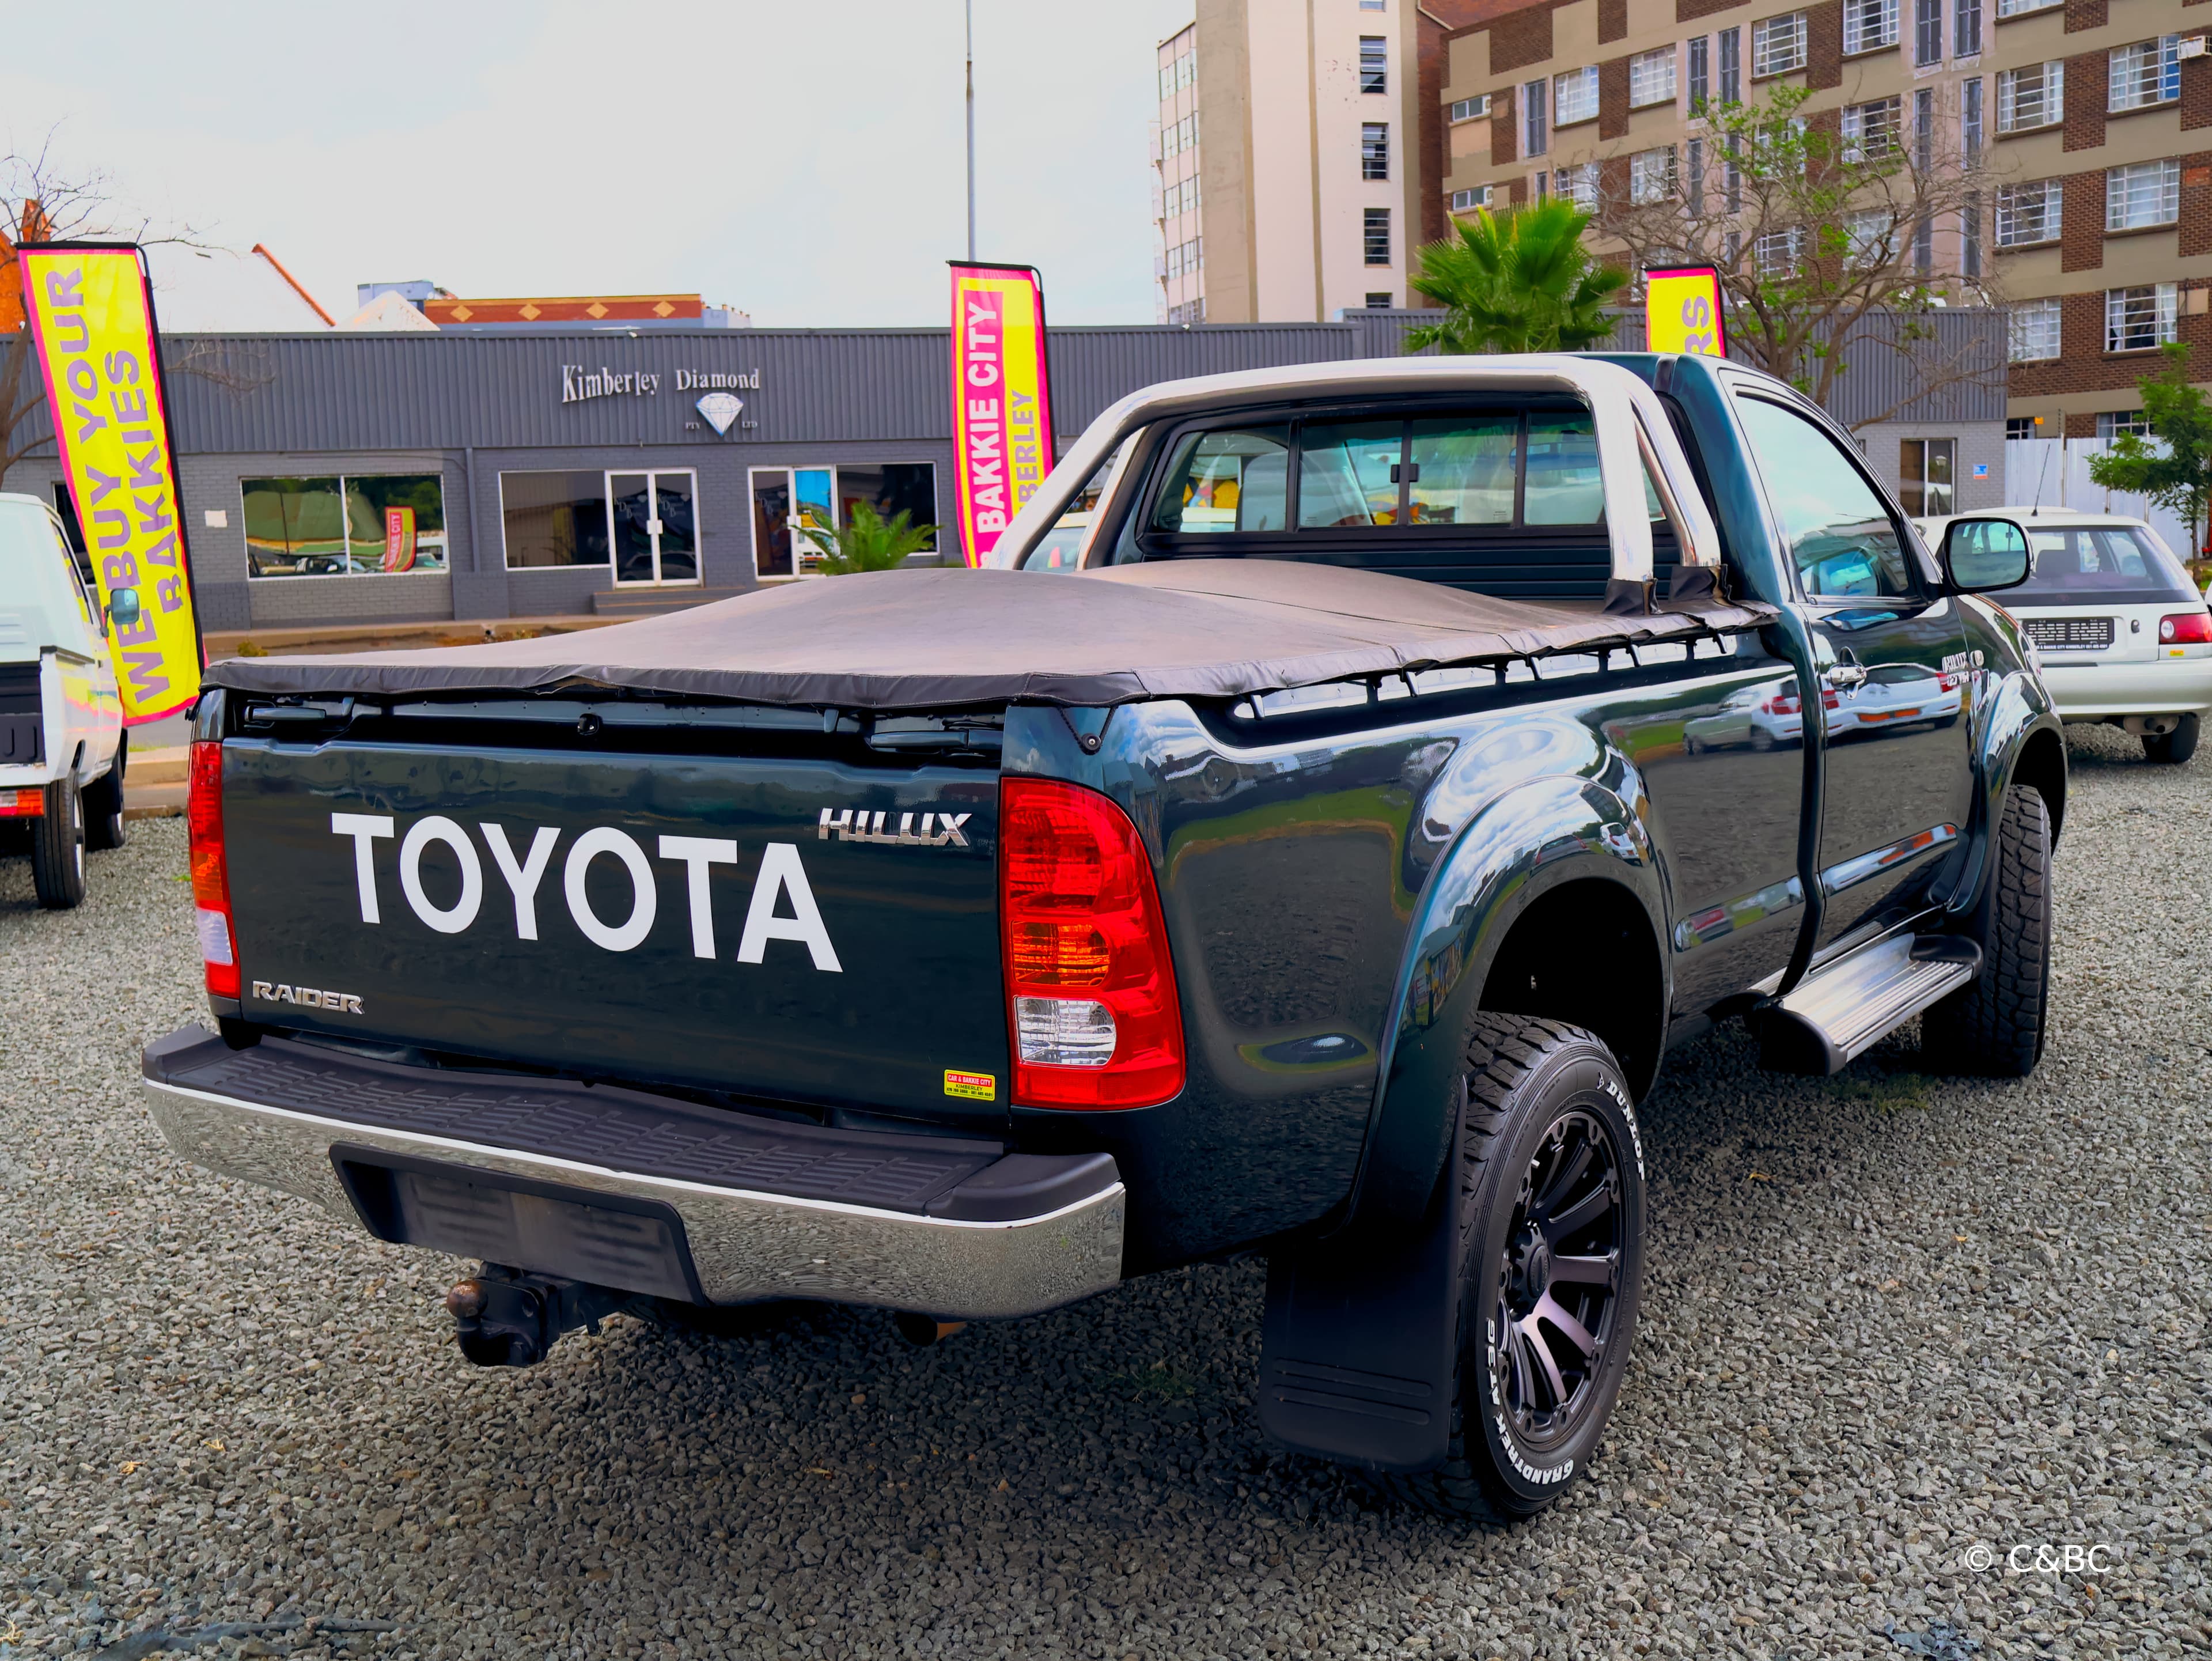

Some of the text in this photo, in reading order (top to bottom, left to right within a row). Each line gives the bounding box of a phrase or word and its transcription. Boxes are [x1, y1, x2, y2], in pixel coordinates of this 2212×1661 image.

[562, 365, 760, 403] Kimberley Diamond
[968, 301, 1006, 534] BAKKIE CITY
[685, 420, 757, 430] PTY LTD
[1012, 389, 1037, 512] BERLEY
[46, 267, 171, 704] WE BUY YOUR
[104, 349, 183, 613] BAKKIES
[819, 807, 972, 846] HILUX
[331, 812, 843, 973] TOYOTA
[253, 981, 363, 1015] RAIDER
[956, 1083, 983, 1091] KIMBERLEY
[963, 1076, 979, 1084] BAKKIE
[1605, 1079, 1645, 1181] DUNLOP
[1495, 1412, 1574, 1485] GRANDTREK
